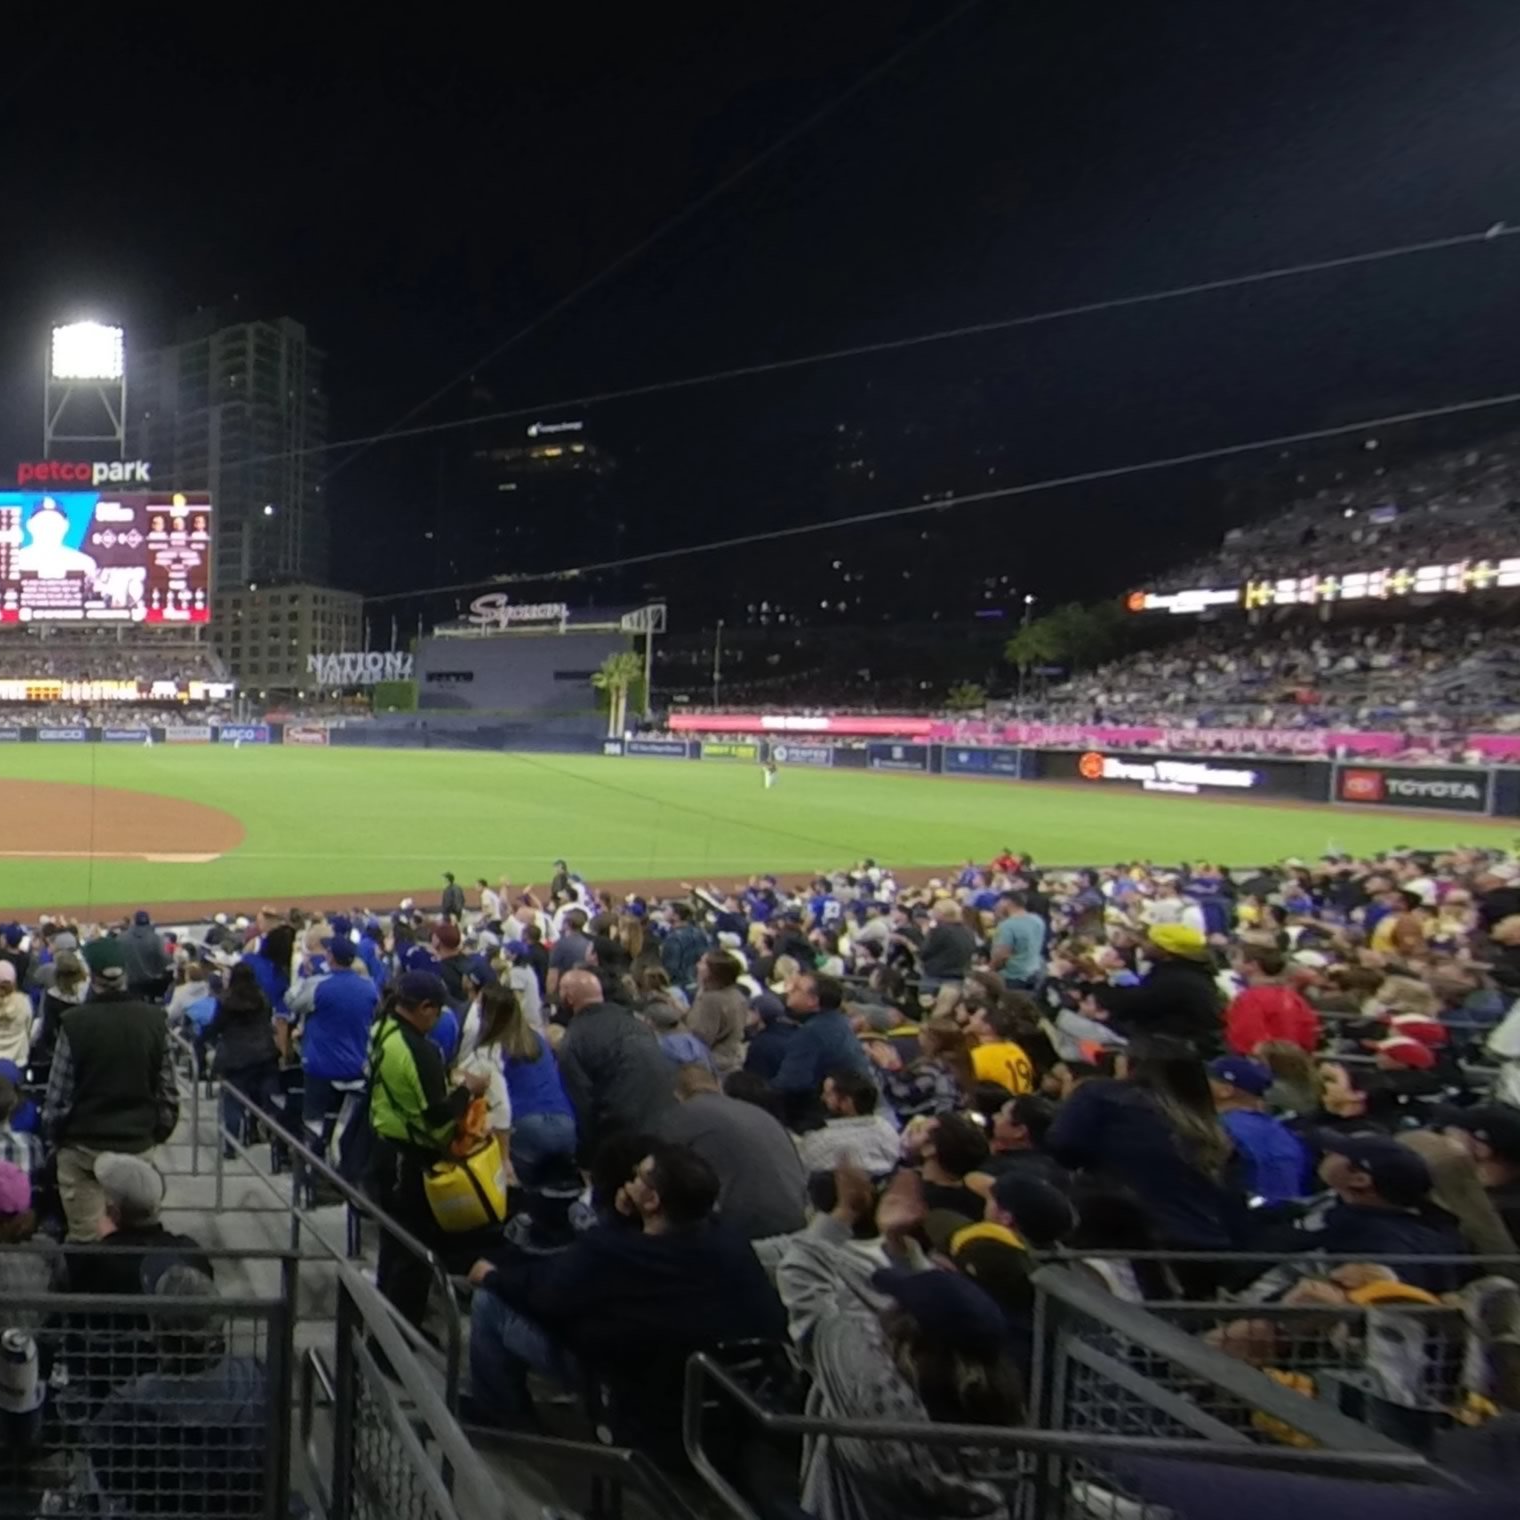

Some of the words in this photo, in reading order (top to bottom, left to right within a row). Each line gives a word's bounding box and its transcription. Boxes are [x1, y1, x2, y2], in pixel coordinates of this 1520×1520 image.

[39, 729, 82, 740] GEICO
[221, 728, 254, 740] ARCO
[1386, 779, 1479, 799] TOYOTA
[1004, 1058, 1032, 1094] 19
